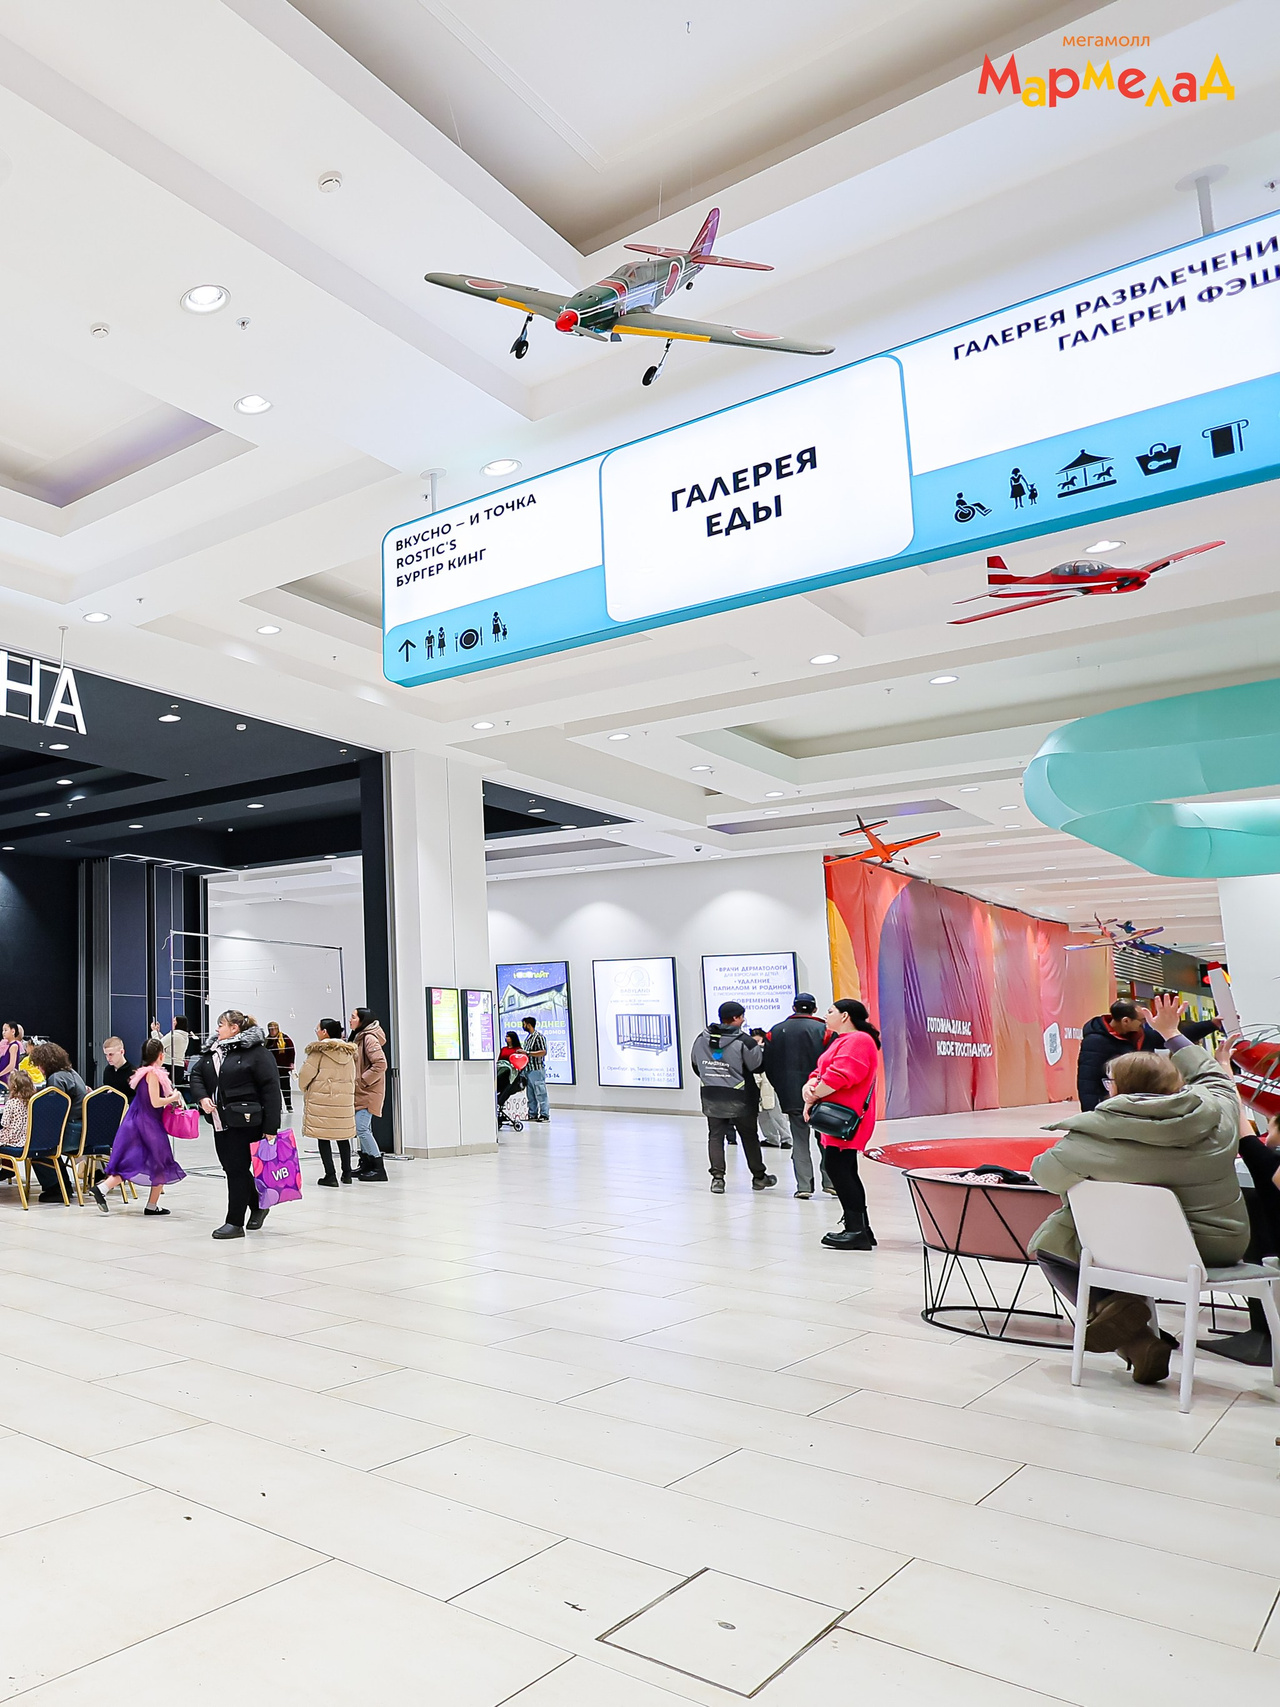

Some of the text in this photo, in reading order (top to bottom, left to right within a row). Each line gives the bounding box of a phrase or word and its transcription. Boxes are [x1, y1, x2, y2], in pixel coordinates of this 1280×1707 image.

[1058, 263, 1280, 352] ГАЛЕРЕИ ФЭШ
[953, 308, 1066, 361] ГАЛЕРЕЯ
[671, 446, 818, 513] ГАЛЕРЕЯ
[395, 523, 452, 552] ВКУСНО
[469, 513, 480, 526] И
[484, 493, 537, 520] ТОЧКА
[706, 494, 783, 538] ЕДЫ
[396, 539, 457, 569] ROSTIC'S
[396, 548, 486, 588] БУРГЕР КИНГ
[504, 1020, 566, 1028] НОВОДНЕЕ
[271, 1166, 289, 1181] WB
